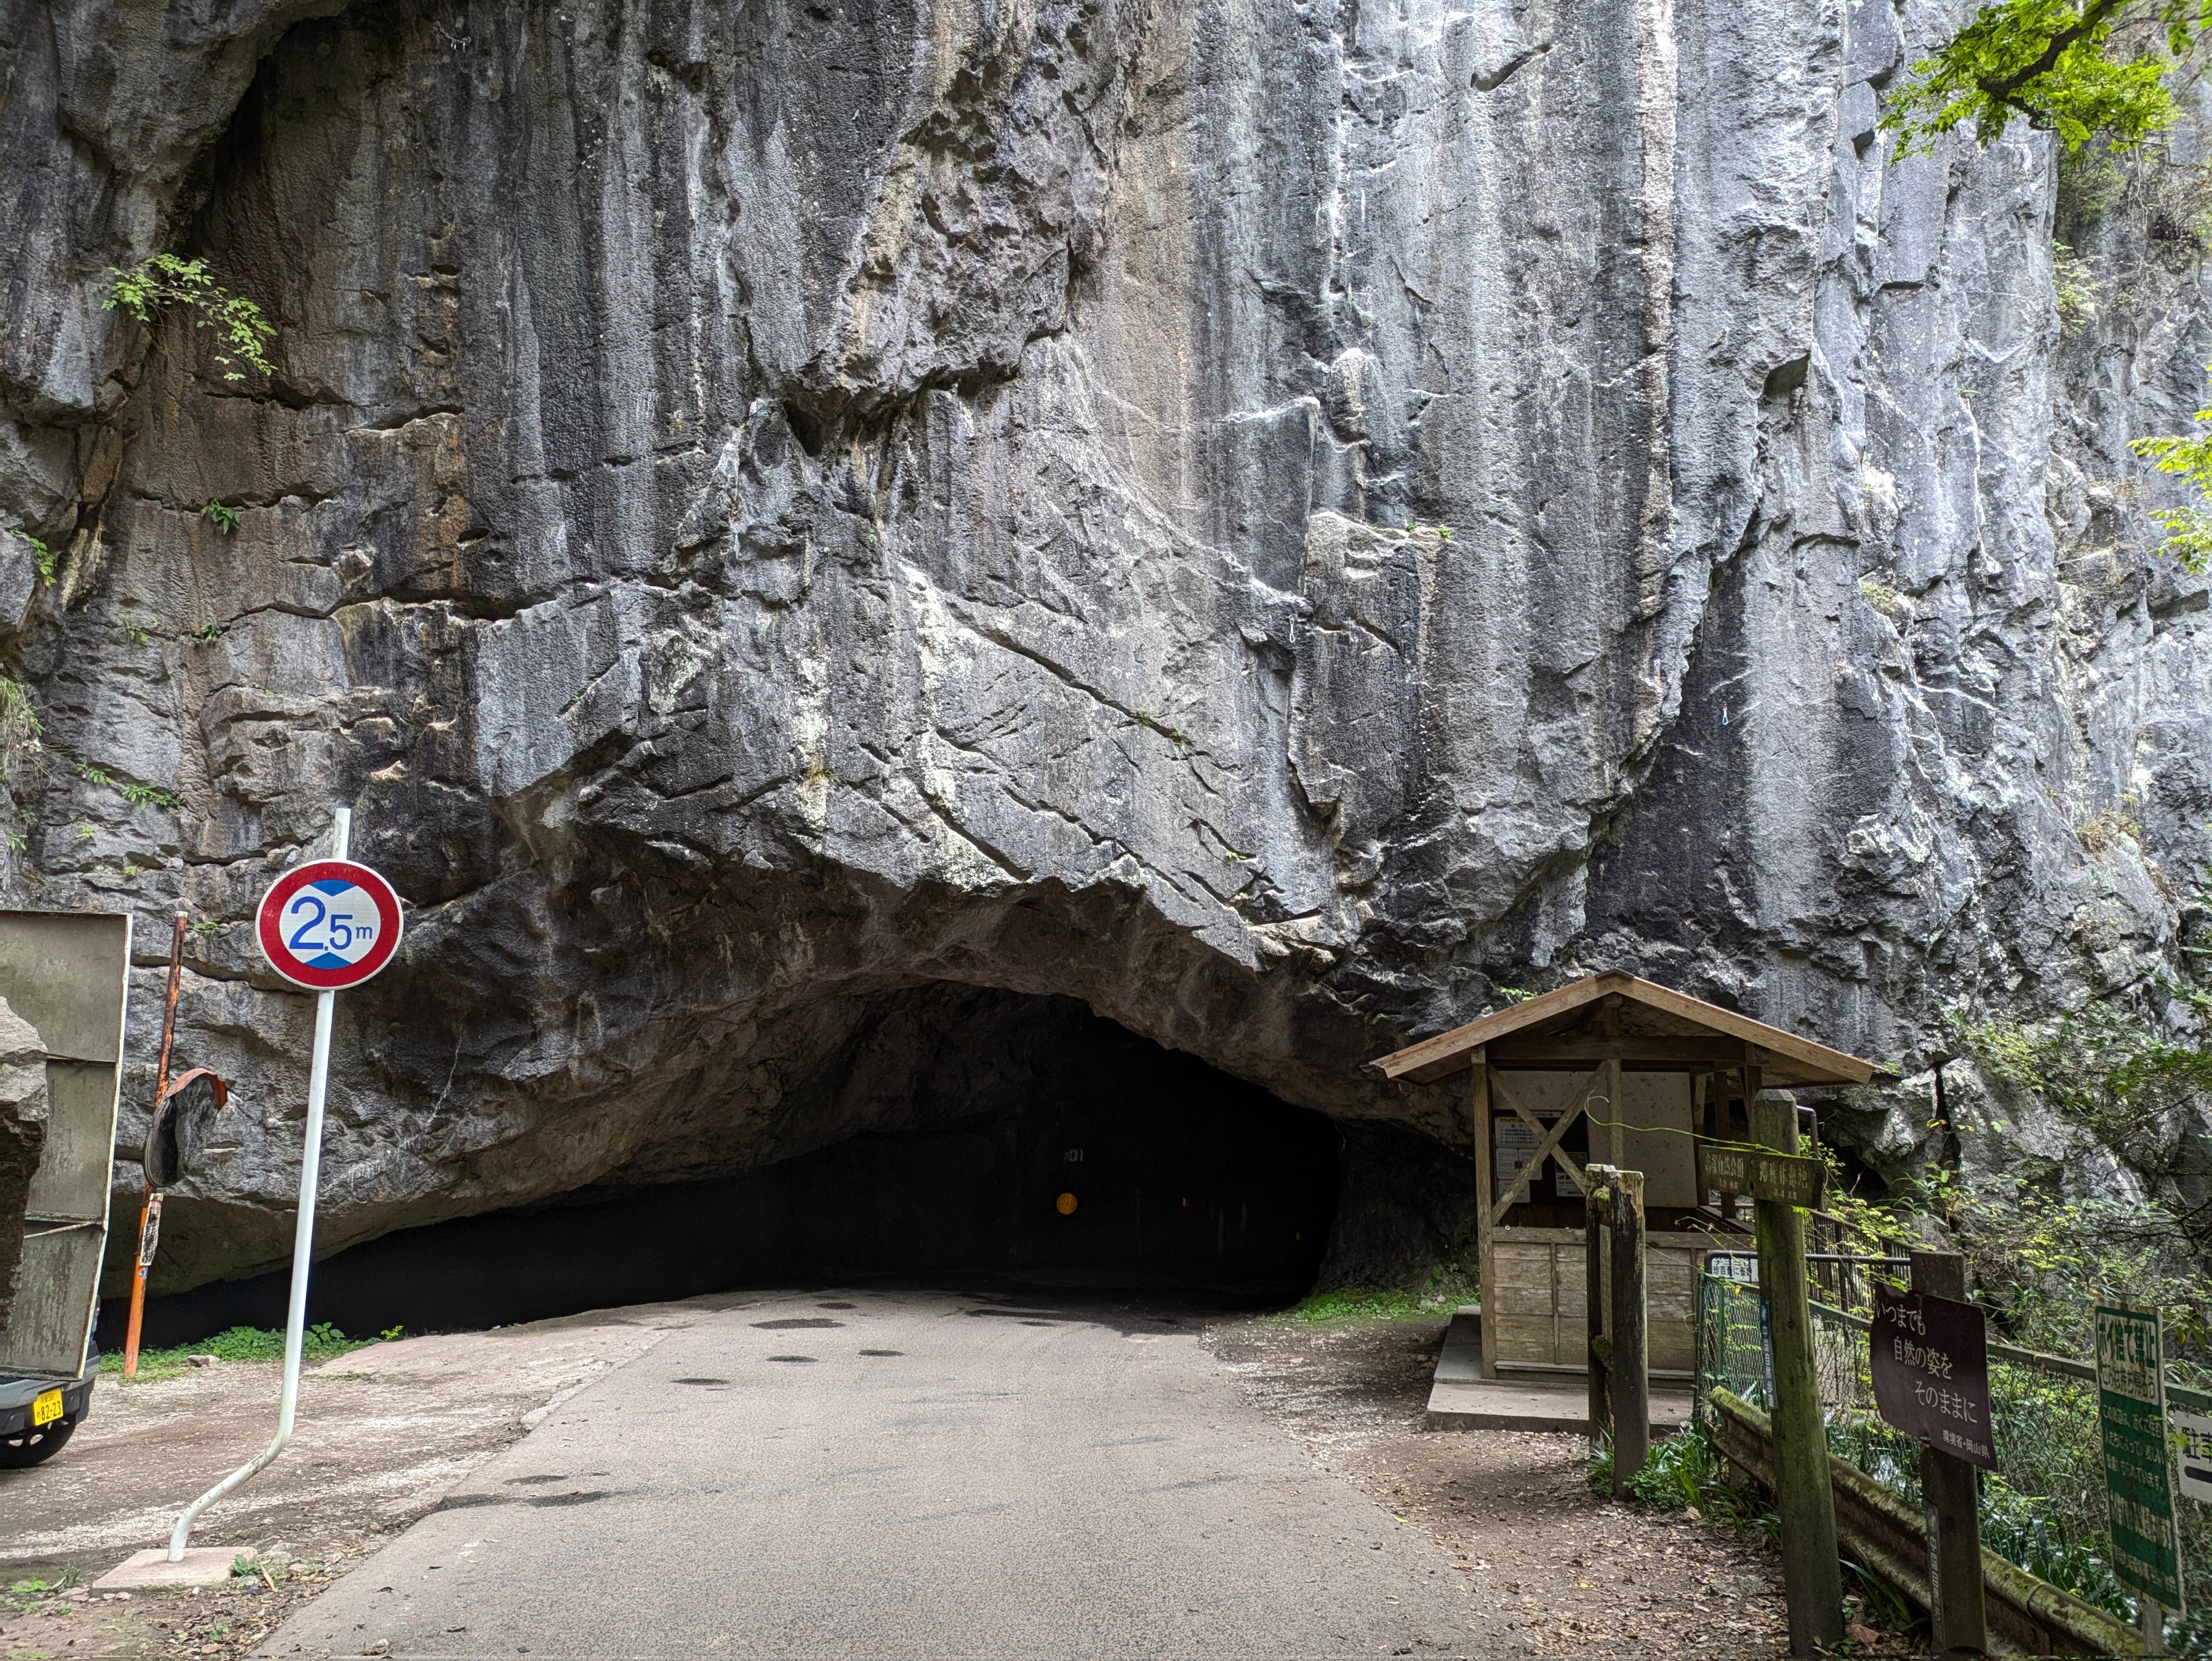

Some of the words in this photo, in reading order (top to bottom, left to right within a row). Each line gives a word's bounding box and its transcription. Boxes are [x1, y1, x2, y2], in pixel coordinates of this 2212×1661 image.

[1876, 1300, 1926, 1335] いつまでも
[1893, 1336, 1952, 1380] 自然の姿を
[2098, 1314, 2156, 1369] ポイ捨て禁止
[1915, 1380, 1978, 1423] そのままに
[1943, 1429, 1990, 1459] 環境省・岡山県
